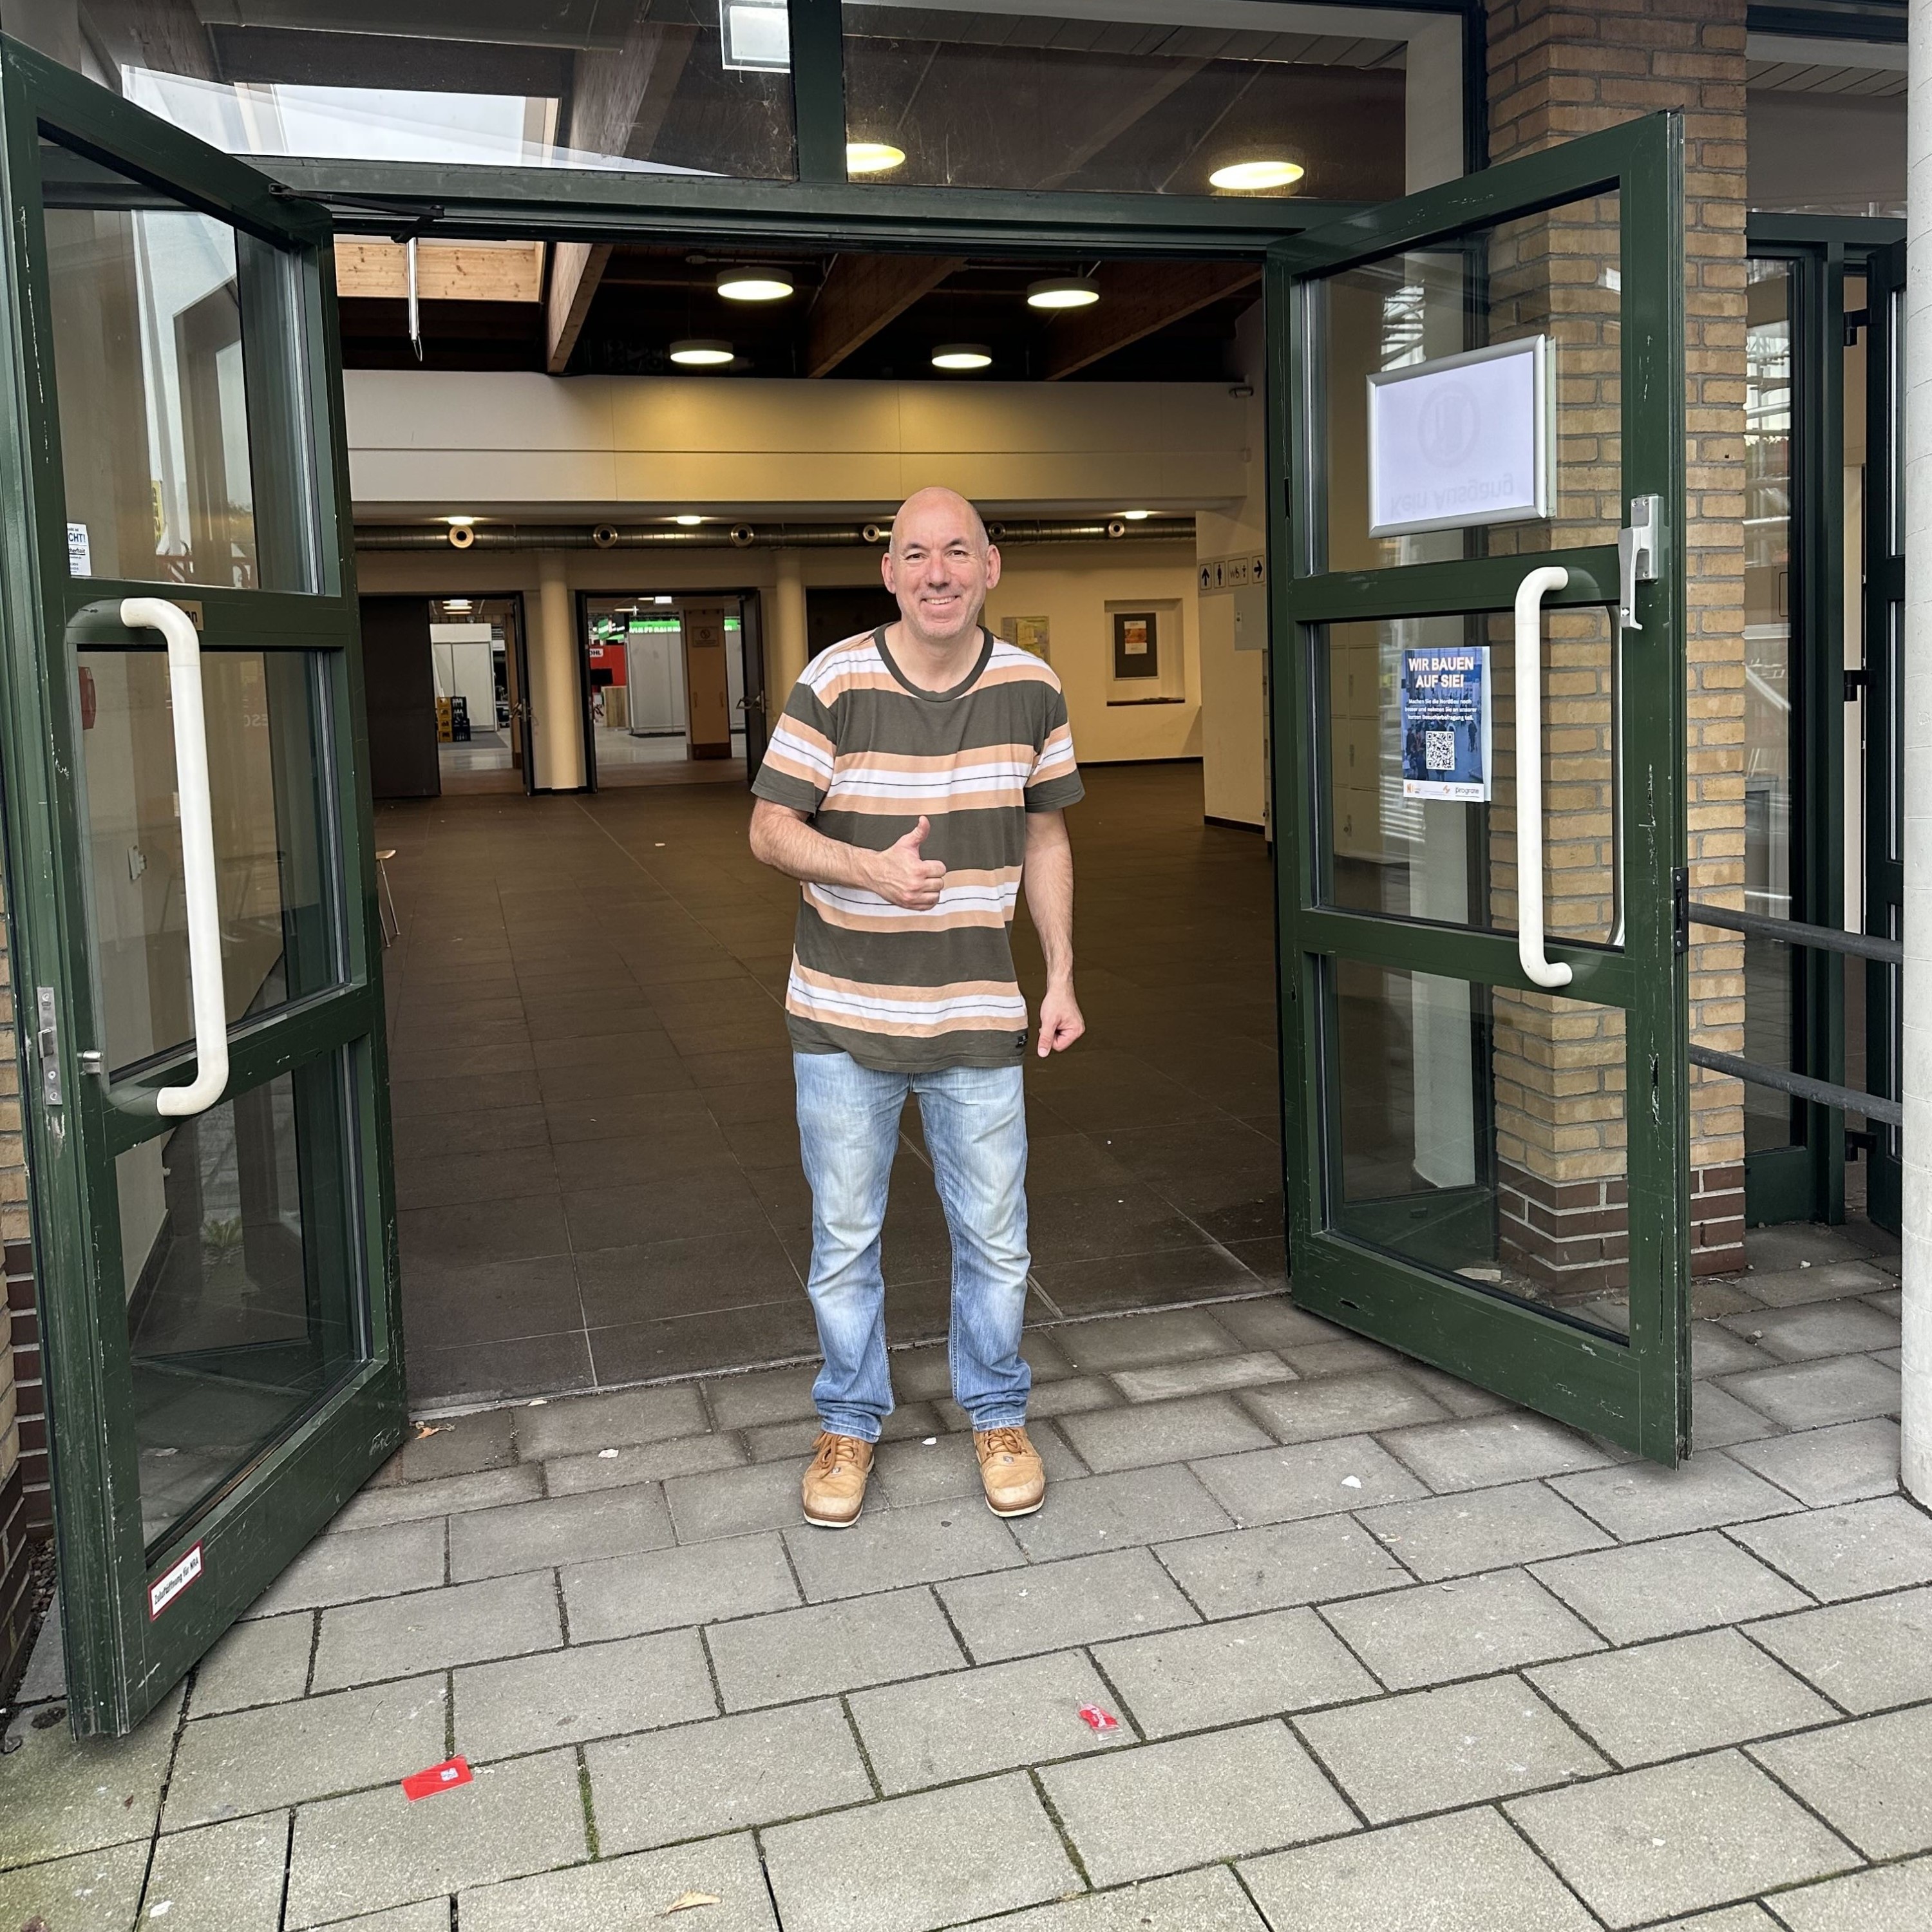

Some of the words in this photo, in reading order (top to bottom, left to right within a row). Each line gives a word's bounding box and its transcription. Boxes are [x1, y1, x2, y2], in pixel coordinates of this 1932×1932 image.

[1408, 658, 1429, 671] WIR
[1431, 657, 1474, 670] BAUEN
[1416, 675, 1439, 688] AUF
[1441, 674, 1464, 688] SIE!
